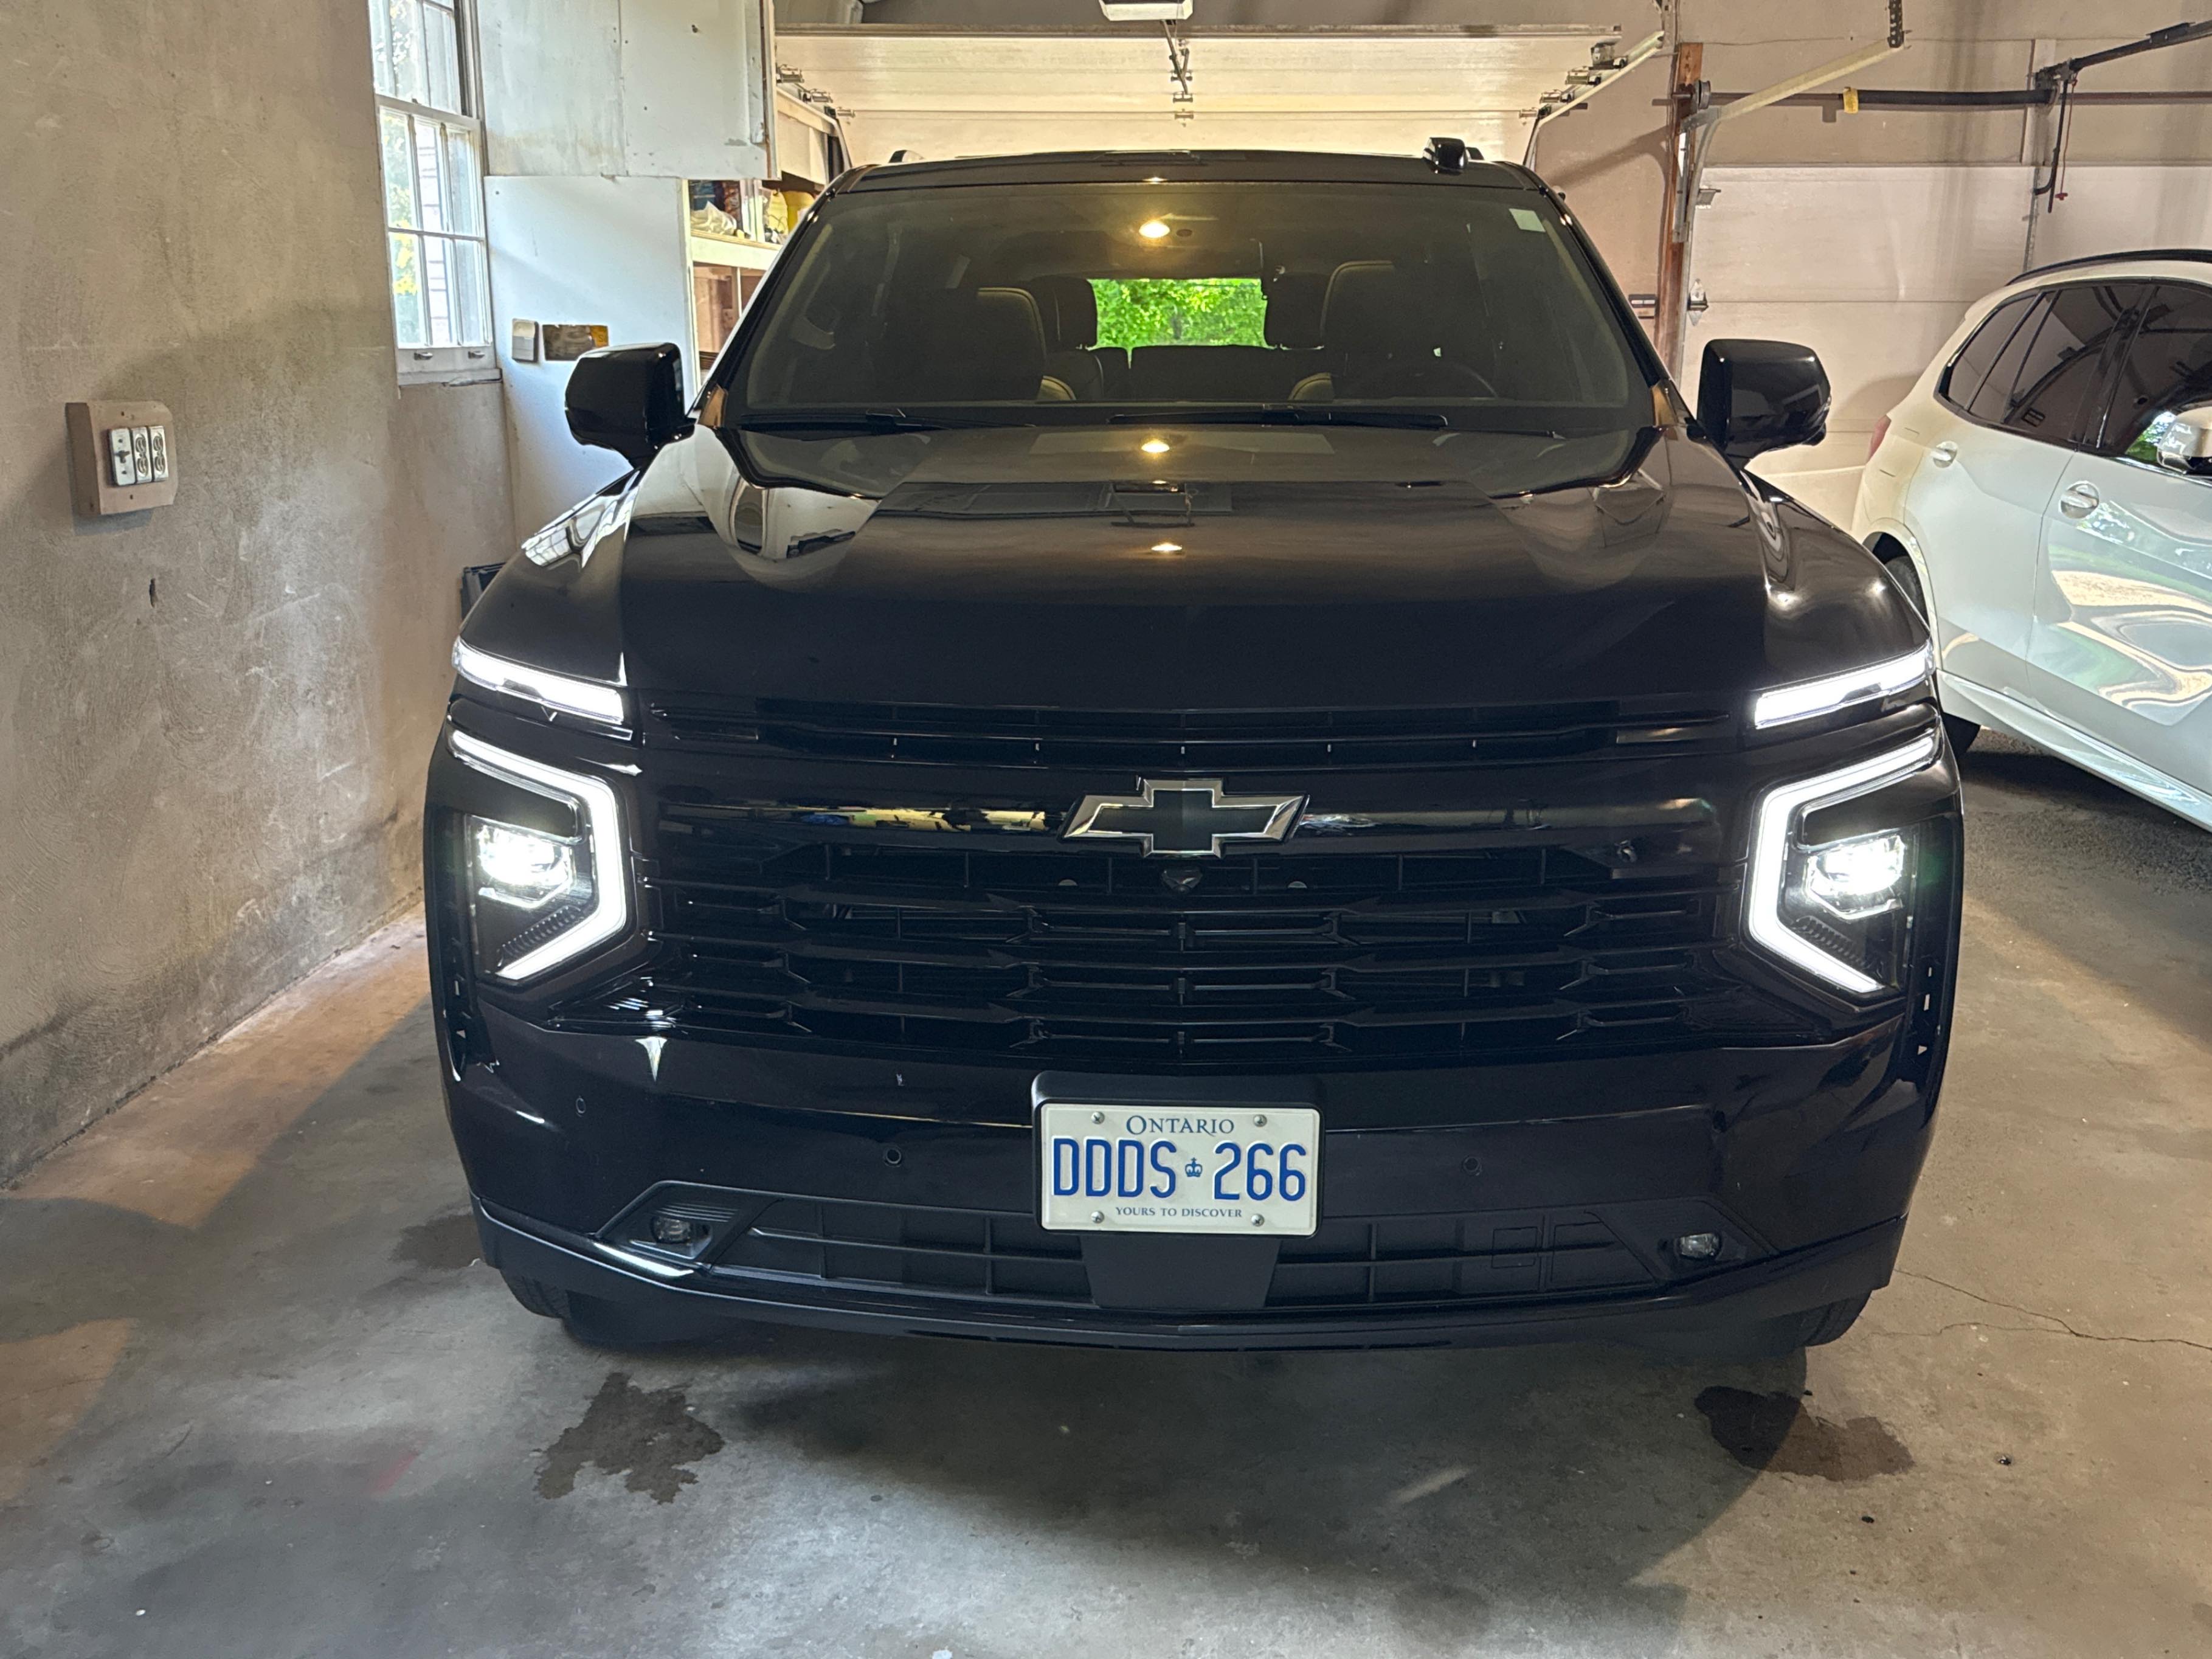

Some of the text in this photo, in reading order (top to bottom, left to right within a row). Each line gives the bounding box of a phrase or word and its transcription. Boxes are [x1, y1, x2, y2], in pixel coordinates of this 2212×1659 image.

[1126, 1115, 1235, 1137] ONTARIO
[1052, 1138, 1307, 1202] DDDS 266
[1116, 1207, 1242, 1217] YOURS TO DISCOVER
